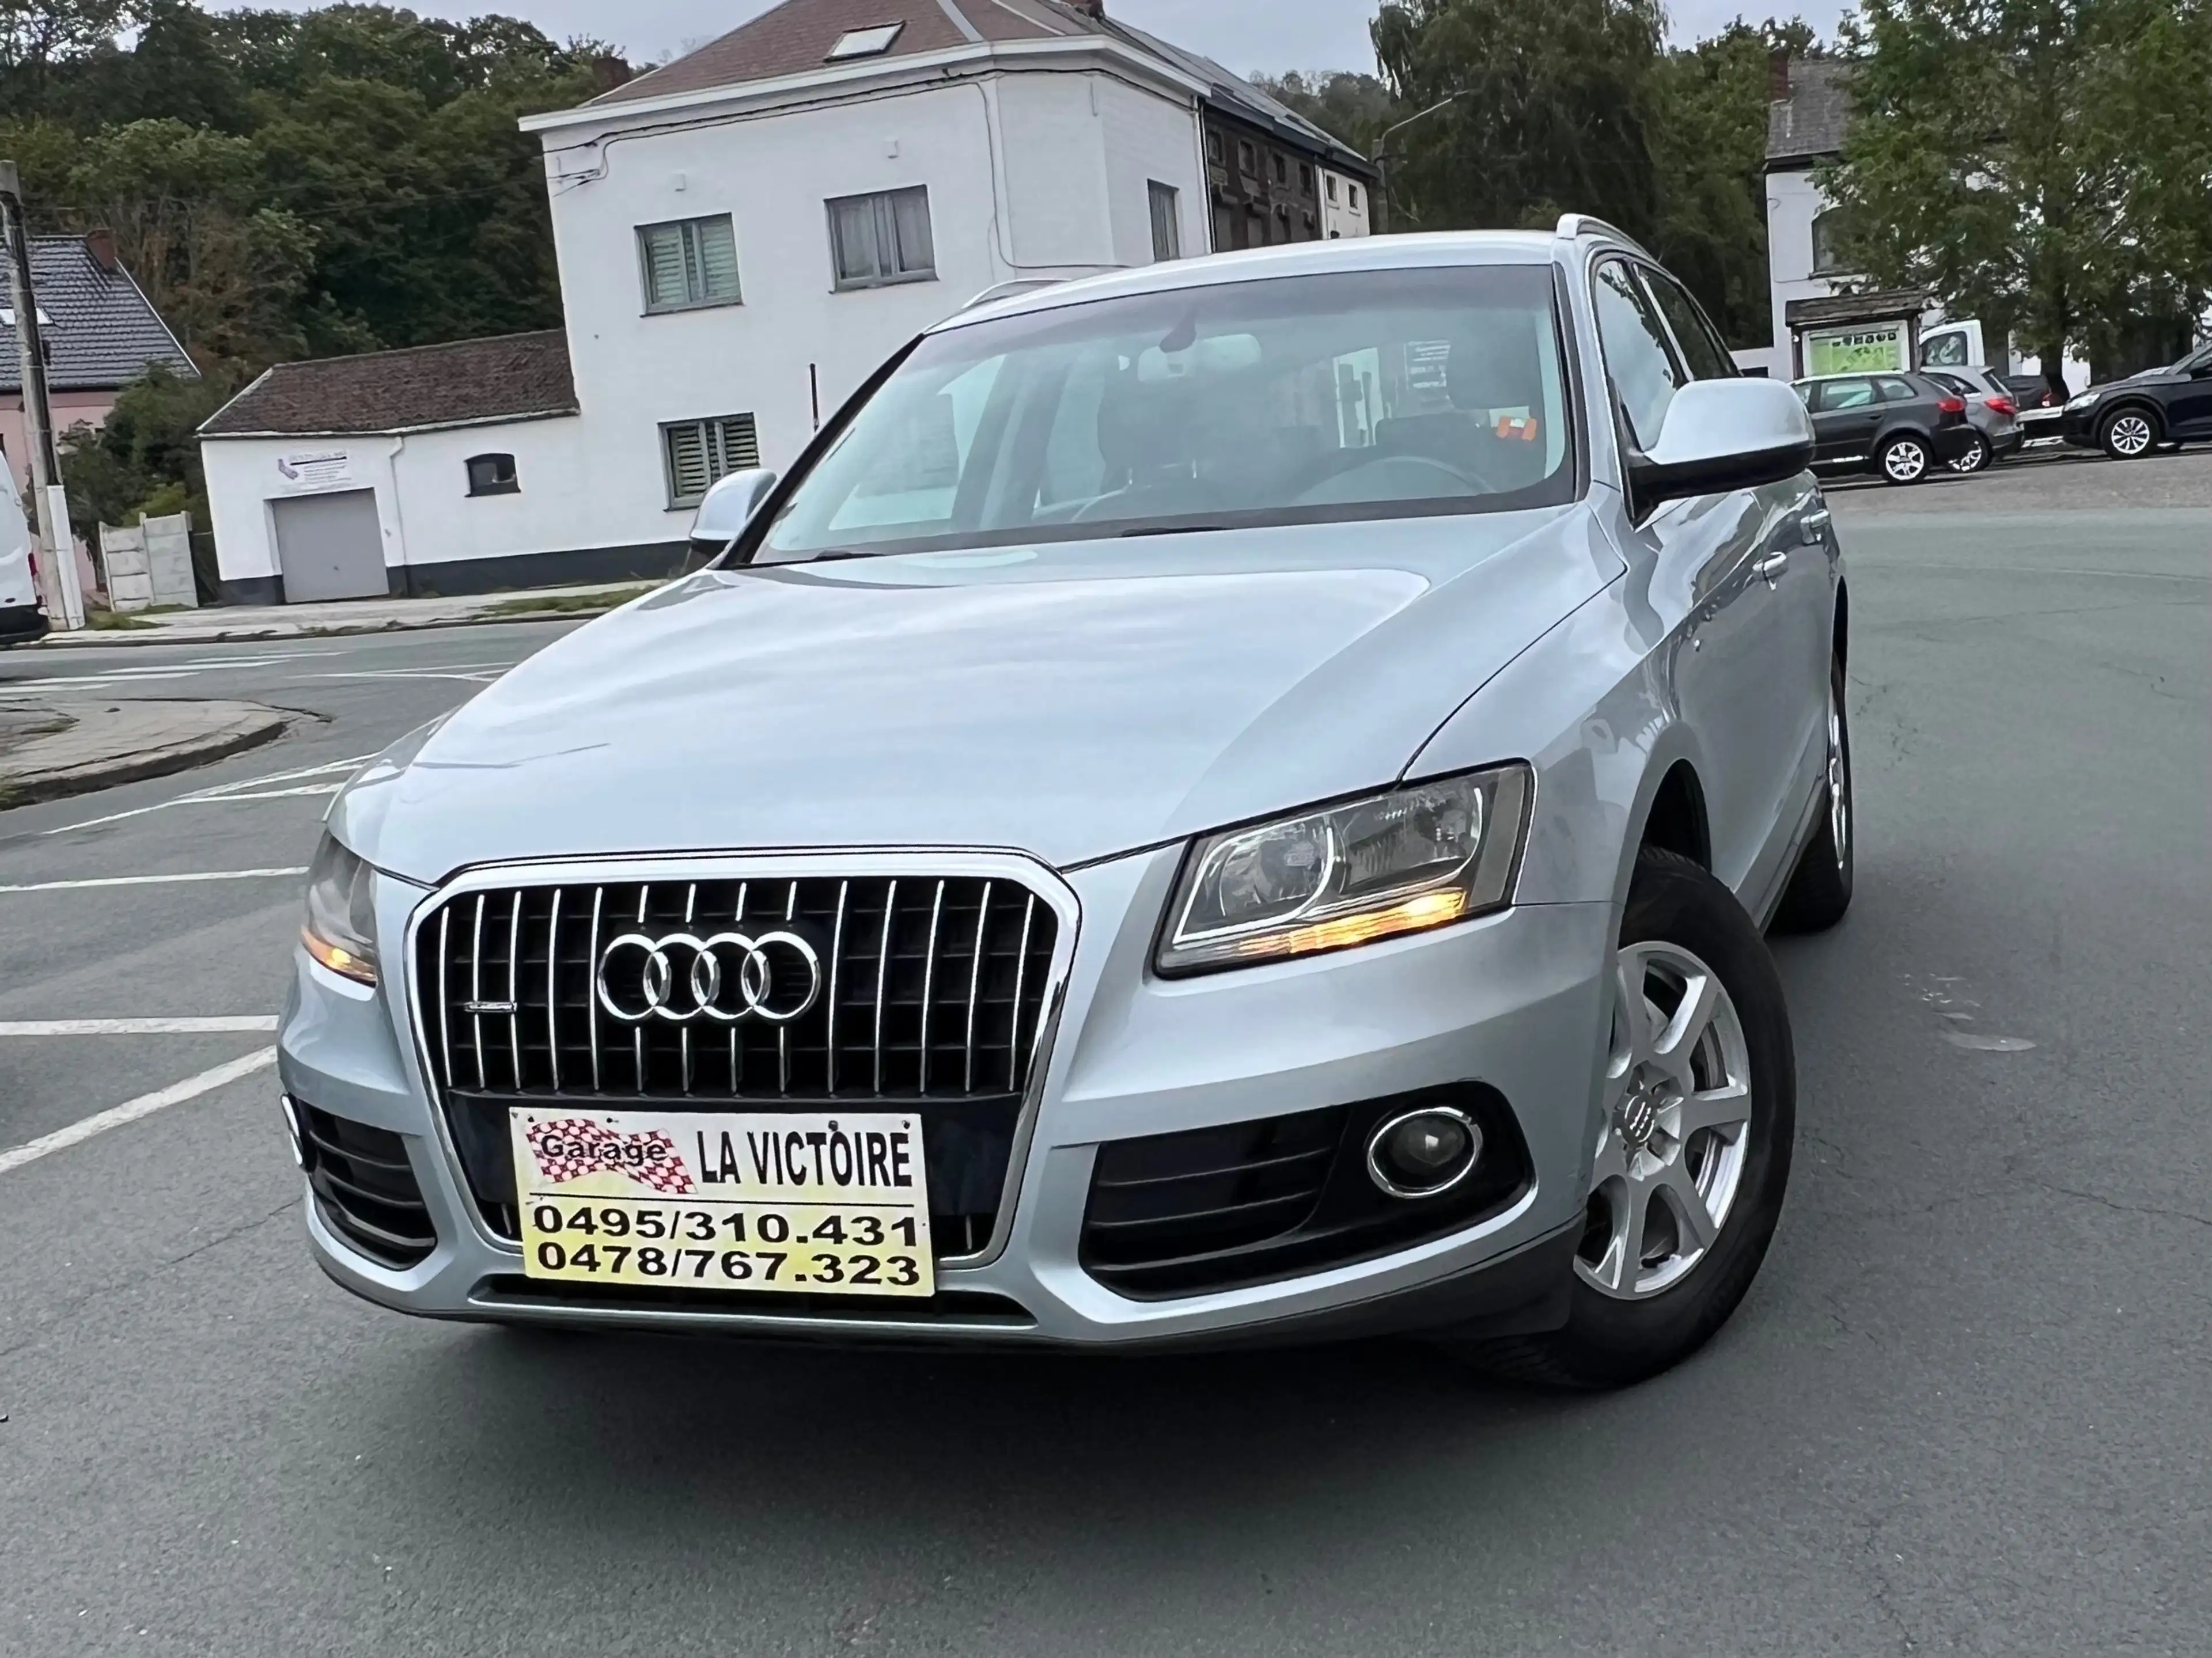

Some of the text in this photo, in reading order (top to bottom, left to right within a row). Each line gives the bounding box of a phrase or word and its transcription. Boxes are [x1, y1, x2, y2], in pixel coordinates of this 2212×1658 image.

[540, 1130, 912, 1187] Garage LA VICTOIRE
[533, 1205, 917, 1247] 0495/310.431
[537, 1242, 920, 1286] 0478/767.323
